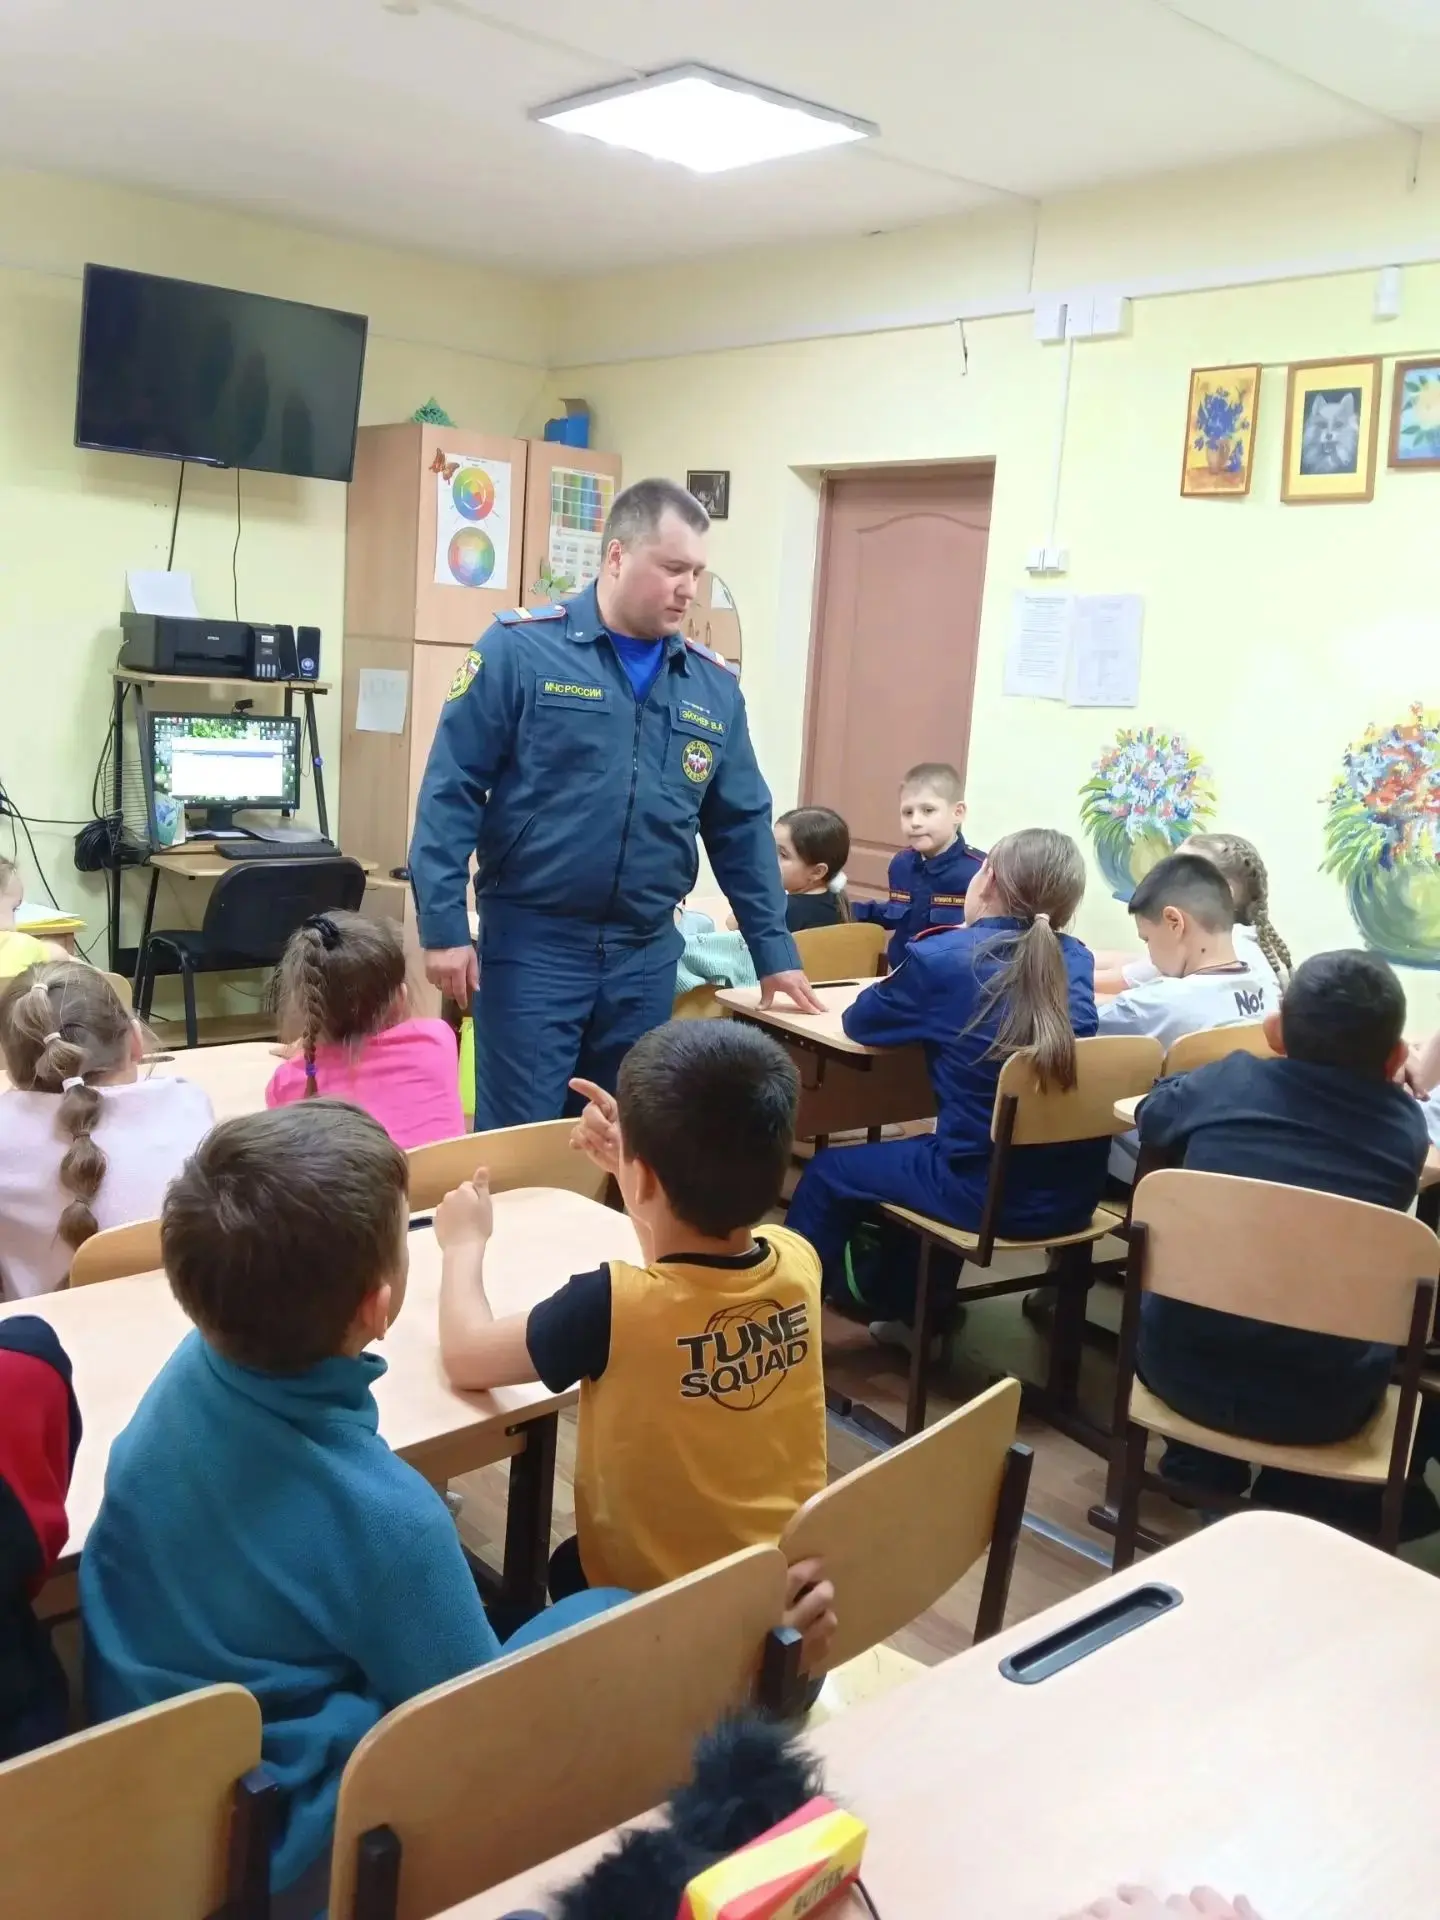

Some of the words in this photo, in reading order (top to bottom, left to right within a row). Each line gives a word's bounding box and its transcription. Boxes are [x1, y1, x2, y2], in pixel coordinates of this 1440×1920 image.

[544, 681, 564, 693] МЧС
[564, 684, 602, 698] РОССИИ
[676, 1302, 810, 1371] TUNE
[680, 1339, 809, 1398] SQUAD
